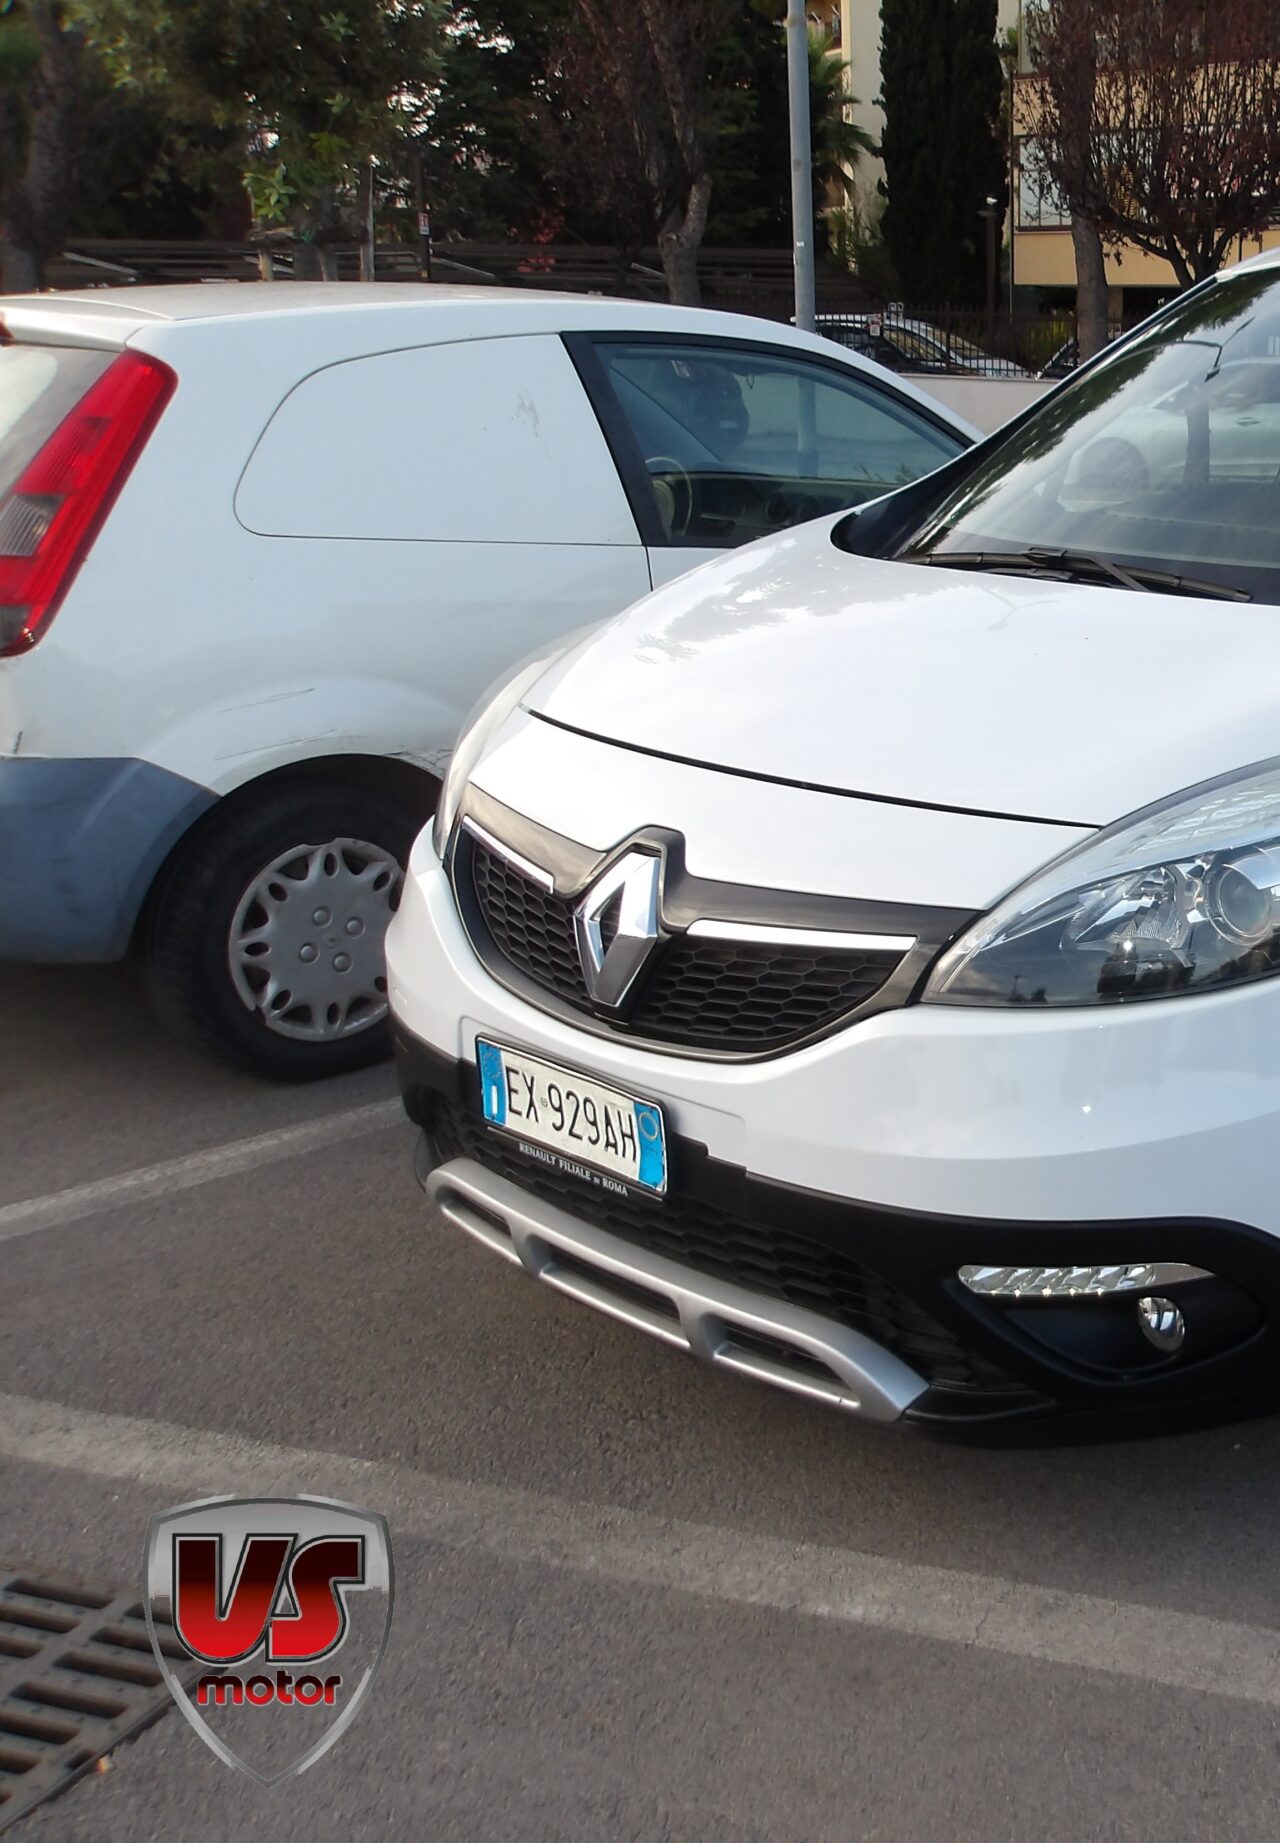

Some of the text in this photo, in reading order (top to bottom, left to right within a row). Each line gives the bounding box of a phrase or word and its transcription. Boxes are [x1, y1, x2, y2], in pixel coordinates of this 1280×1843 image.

[505, 1065, 637, 1162] EX 929AH
[519, 1142, 557, 1166] RENAULT
[559, 1159, 592, 1181] FILIALE
[602, 1177, 629, 1197] ROMA
